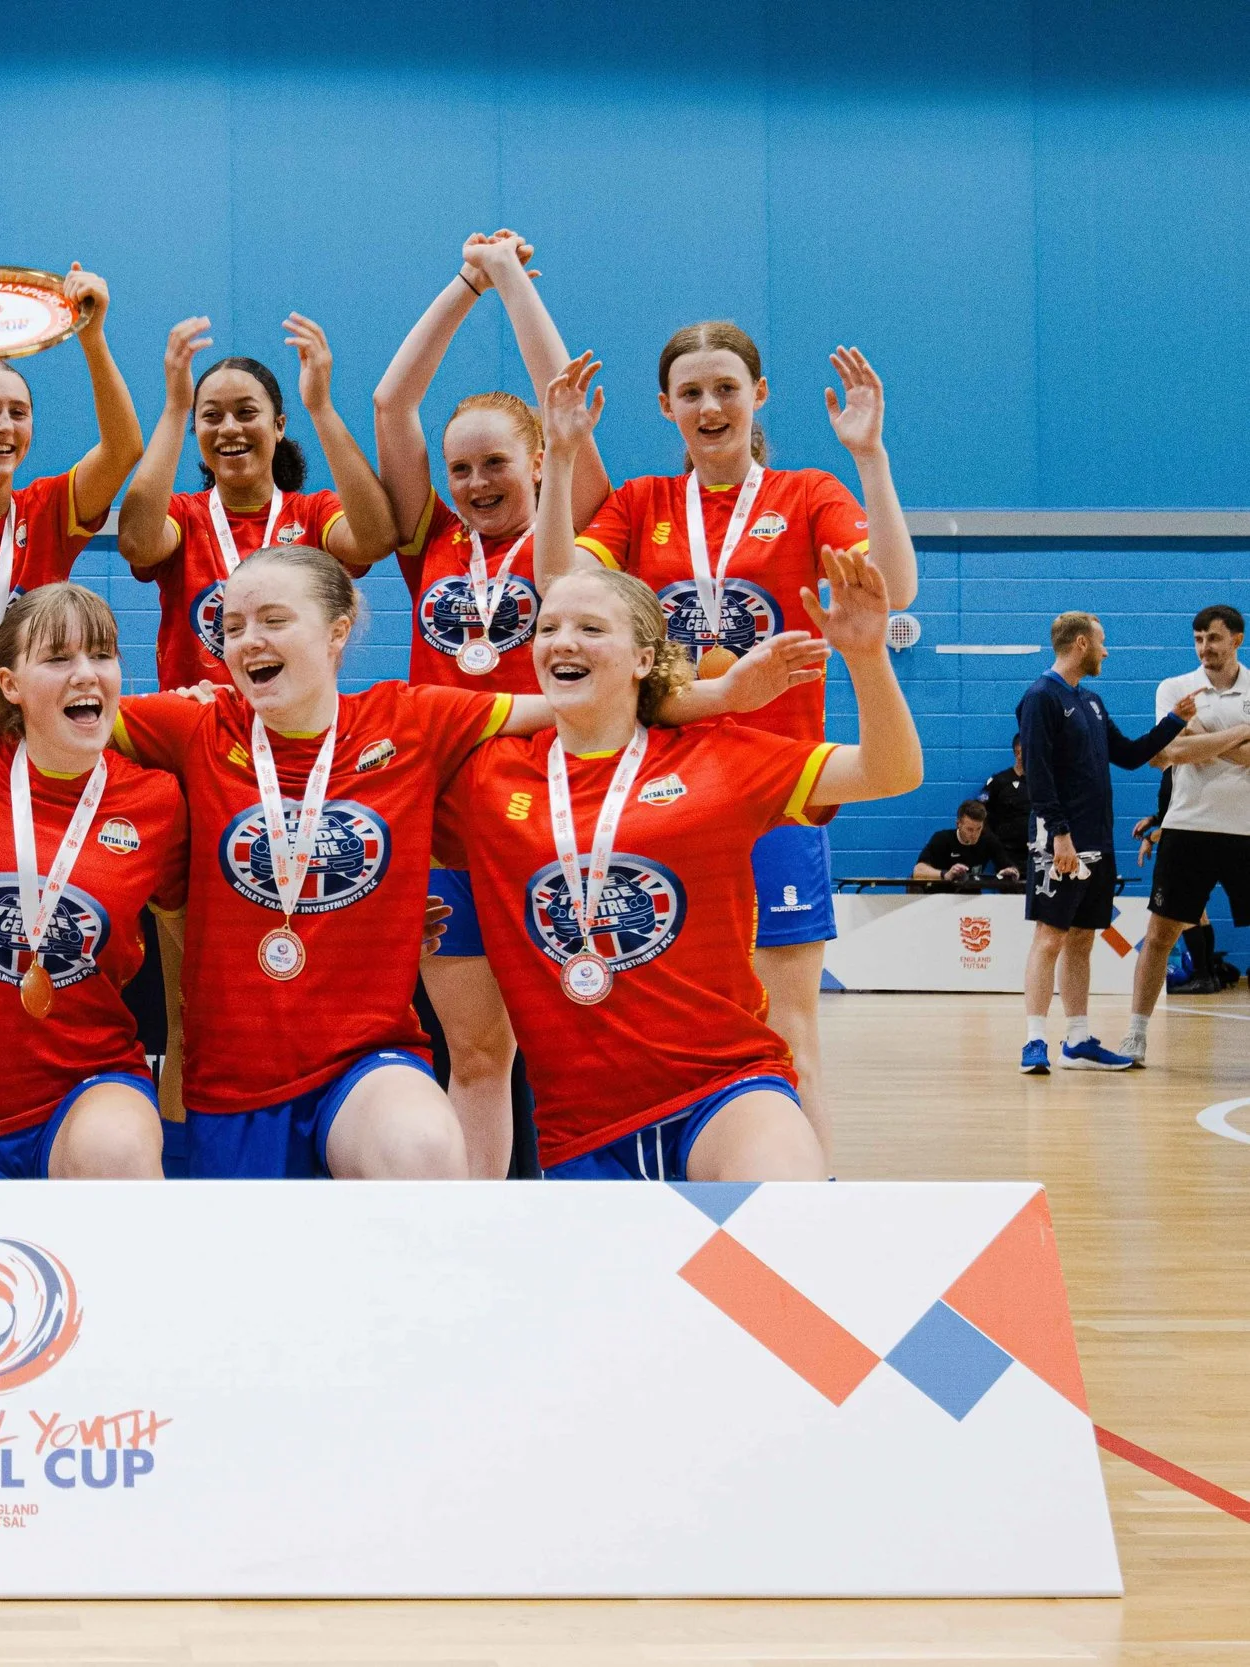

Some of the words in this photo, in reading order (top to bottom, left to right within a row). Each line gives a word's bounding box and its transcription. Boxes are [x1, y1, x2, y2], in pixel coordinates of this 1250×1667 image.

[681, 607, 742, 618] TRDE
[666, 787, 684, 796] CLUB
[101, 835, 121, 845] FUTSAL
[123, 839, 138, 849] CLUB
[233, 881, 266, 904] BAILEY
[264, 900, 299, 913] FAMY
[301, 890, 363, 913] INVESTMENTS
[364, 879, 379, 895] PLC
[543, 946, 568, 964] BAILE
[611, 945, 662, 972] NVESTMENTS
[662, 932, 676, 948] PLC
[28, 1408, 174, 1455] YOUTH
[43, 1448, 155, 1489] CUP
